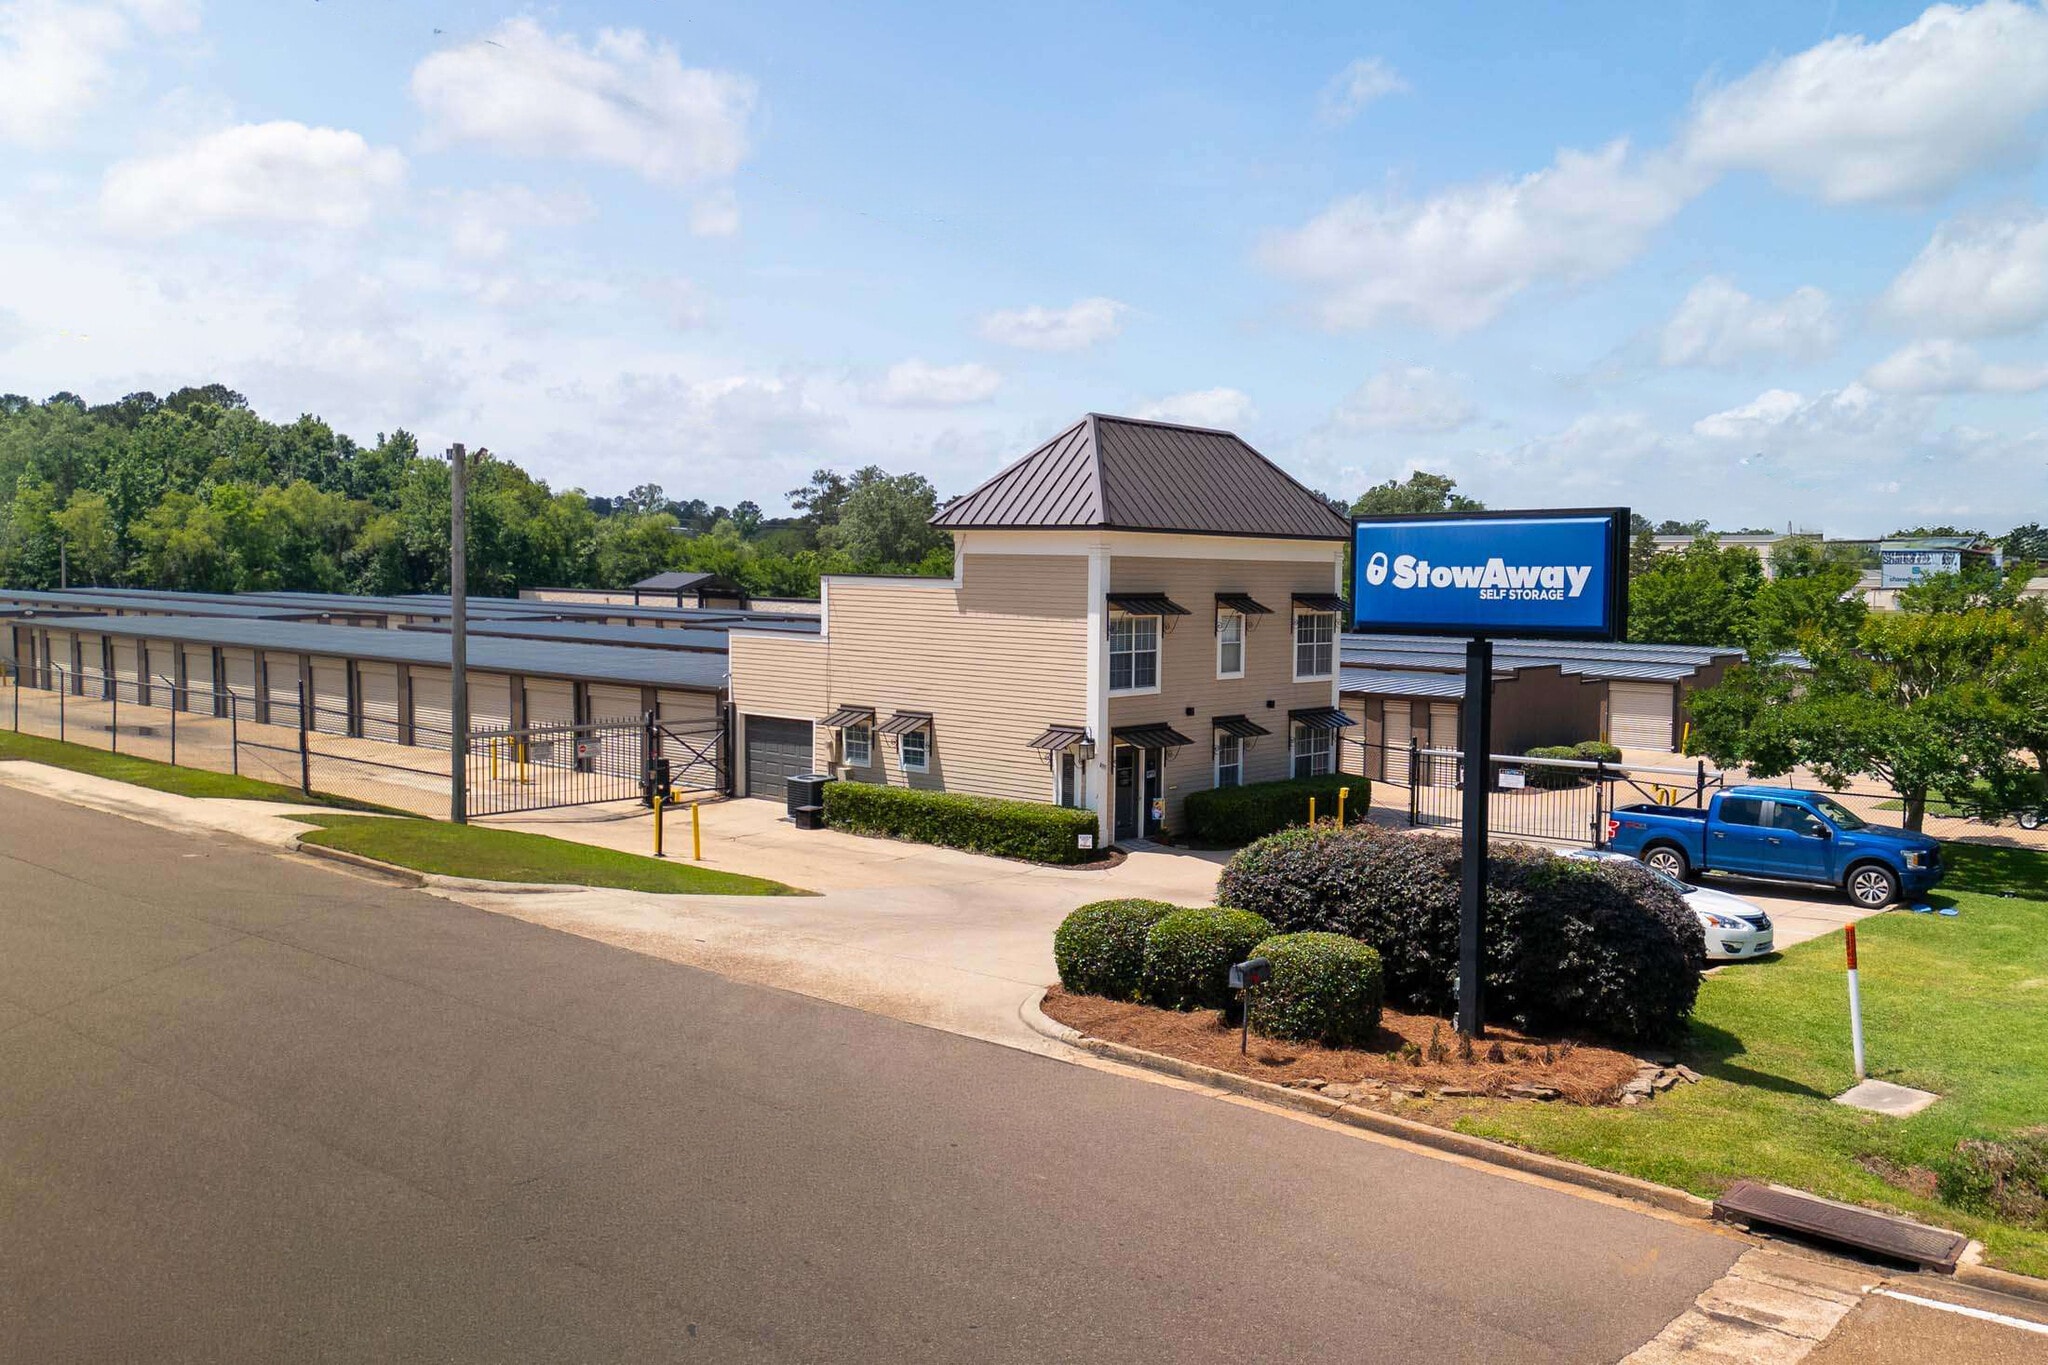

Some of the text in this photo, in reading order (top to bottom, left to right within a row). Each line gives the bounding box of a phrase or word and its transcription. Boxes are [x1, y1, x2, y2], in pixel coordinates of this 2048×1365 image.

[1392, 555, 1591, 597] StowAway
[1479, 589, 1564, 600] SELF STORAGE
